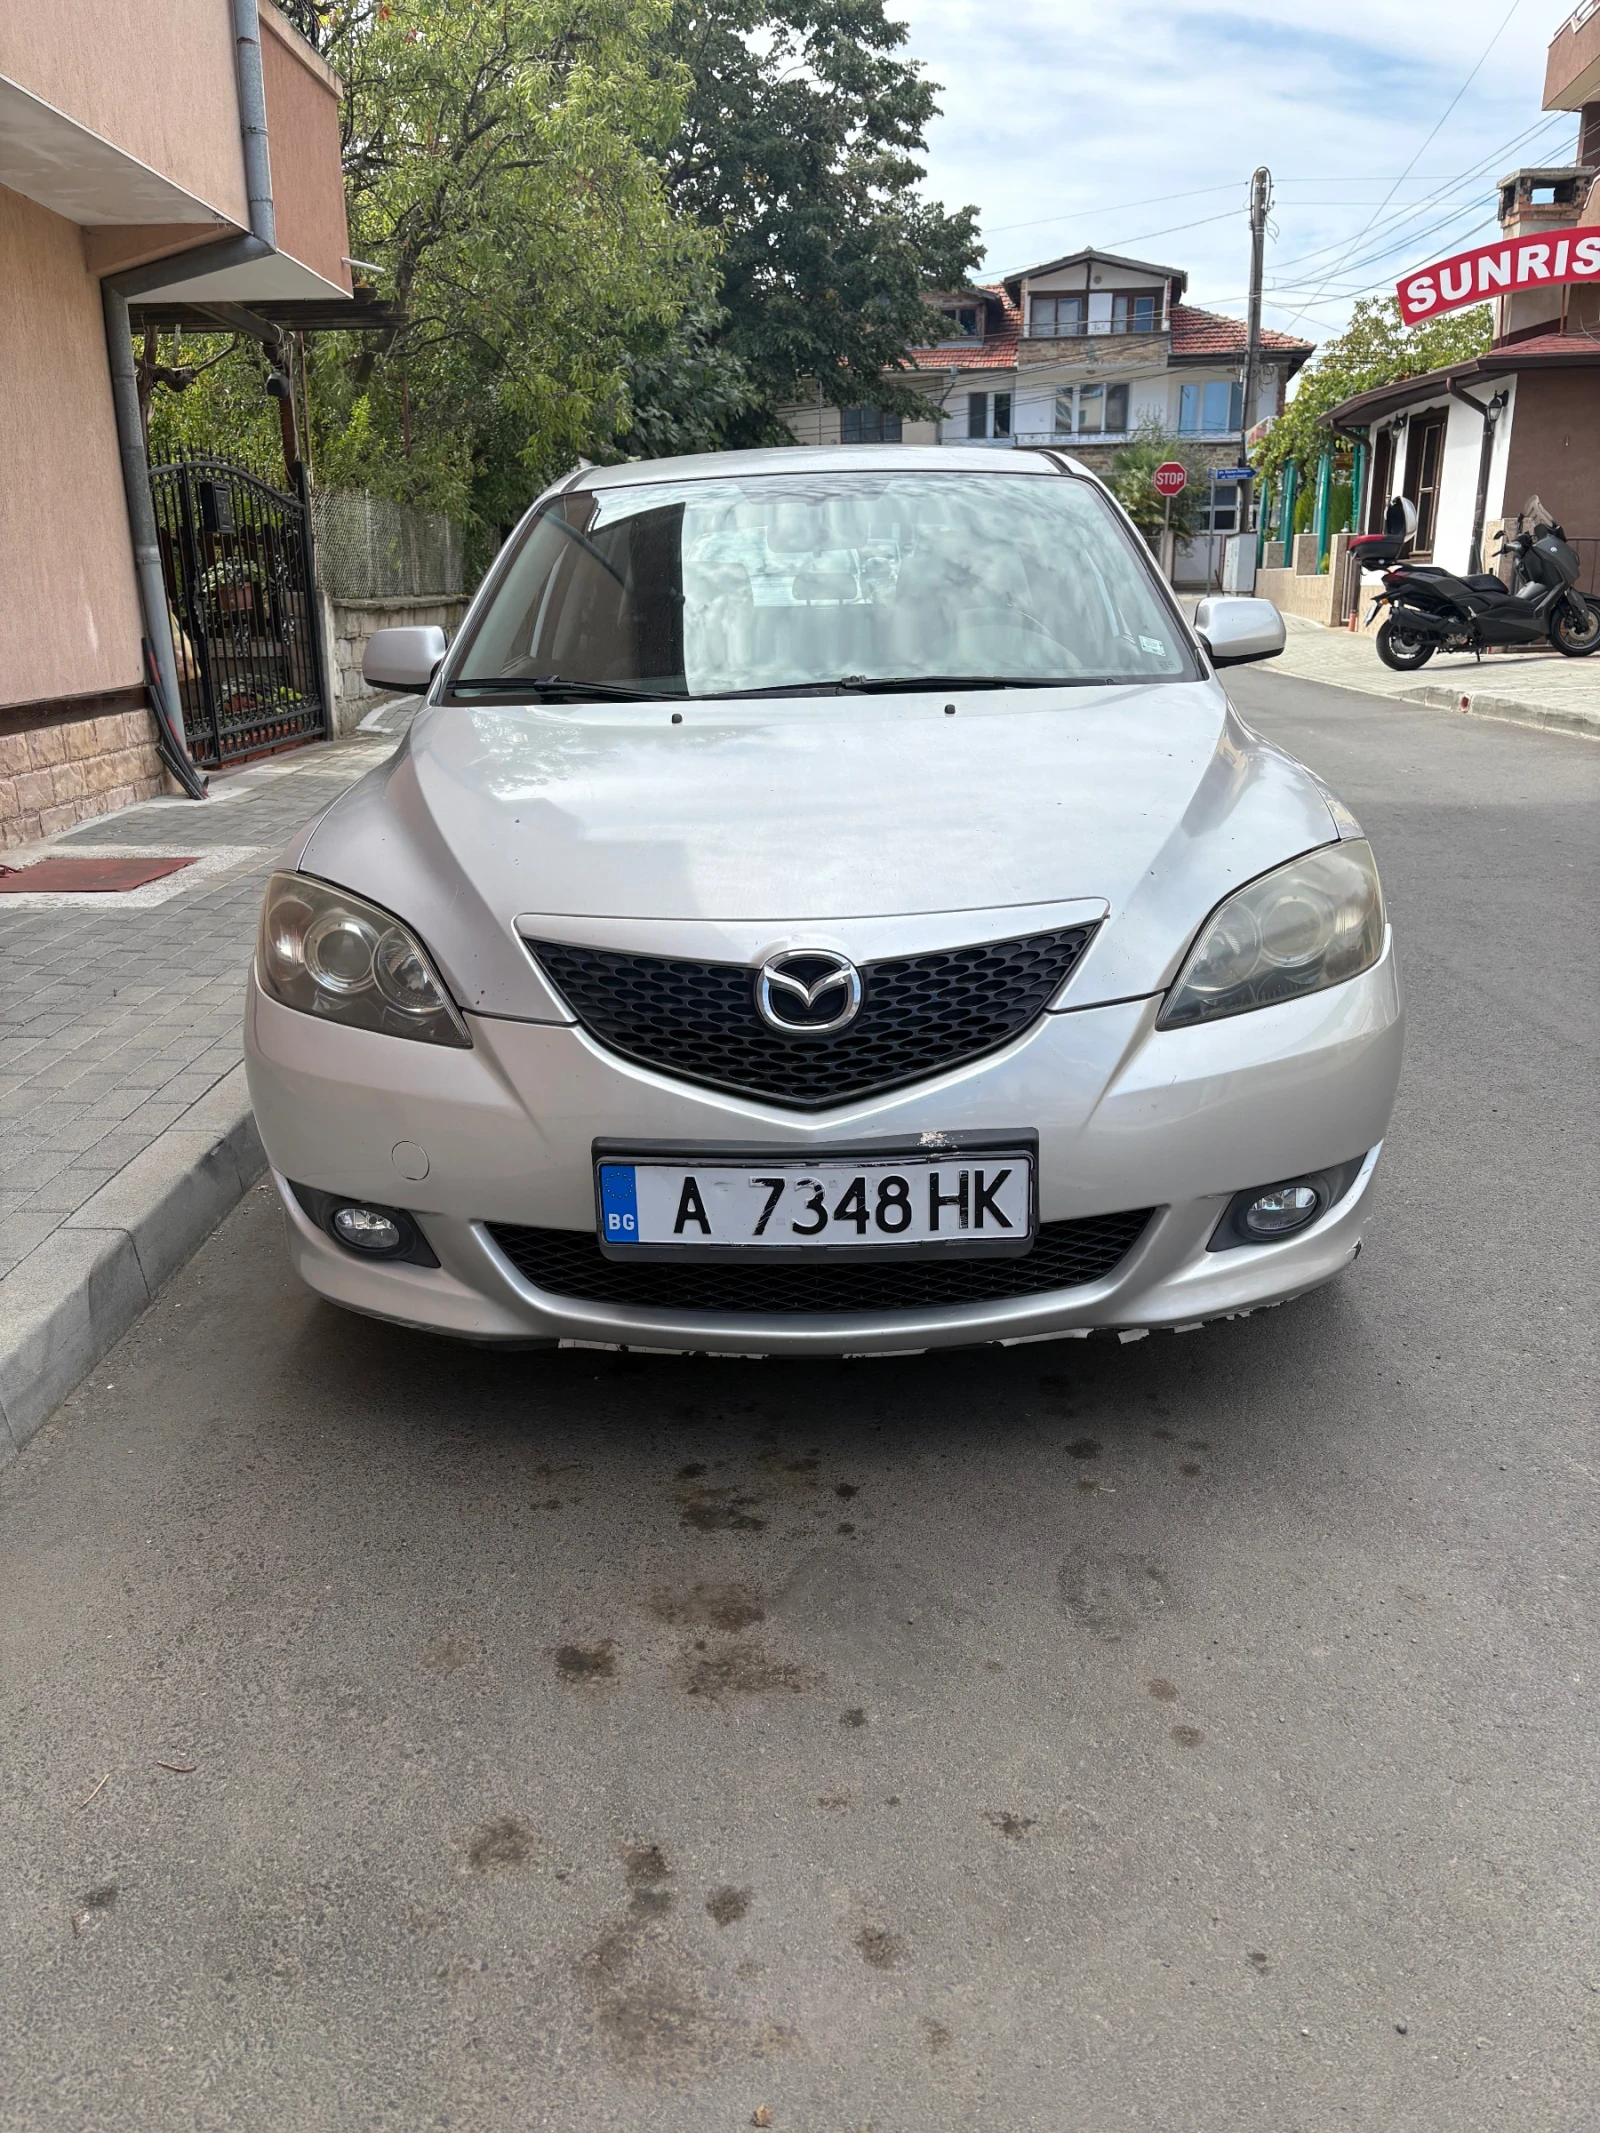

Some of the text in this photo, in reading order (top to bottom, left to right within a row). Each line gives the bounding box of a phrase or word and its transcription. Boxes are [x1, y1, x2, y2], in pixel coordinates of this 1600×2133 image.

[1407, 236, 1600, 313] SUNRIS
[1156, 472, 1184, 485] STOP
[608, 1213, 635, 1231] BG
[673, 1168, 1013, 1236] A 7348 HK
